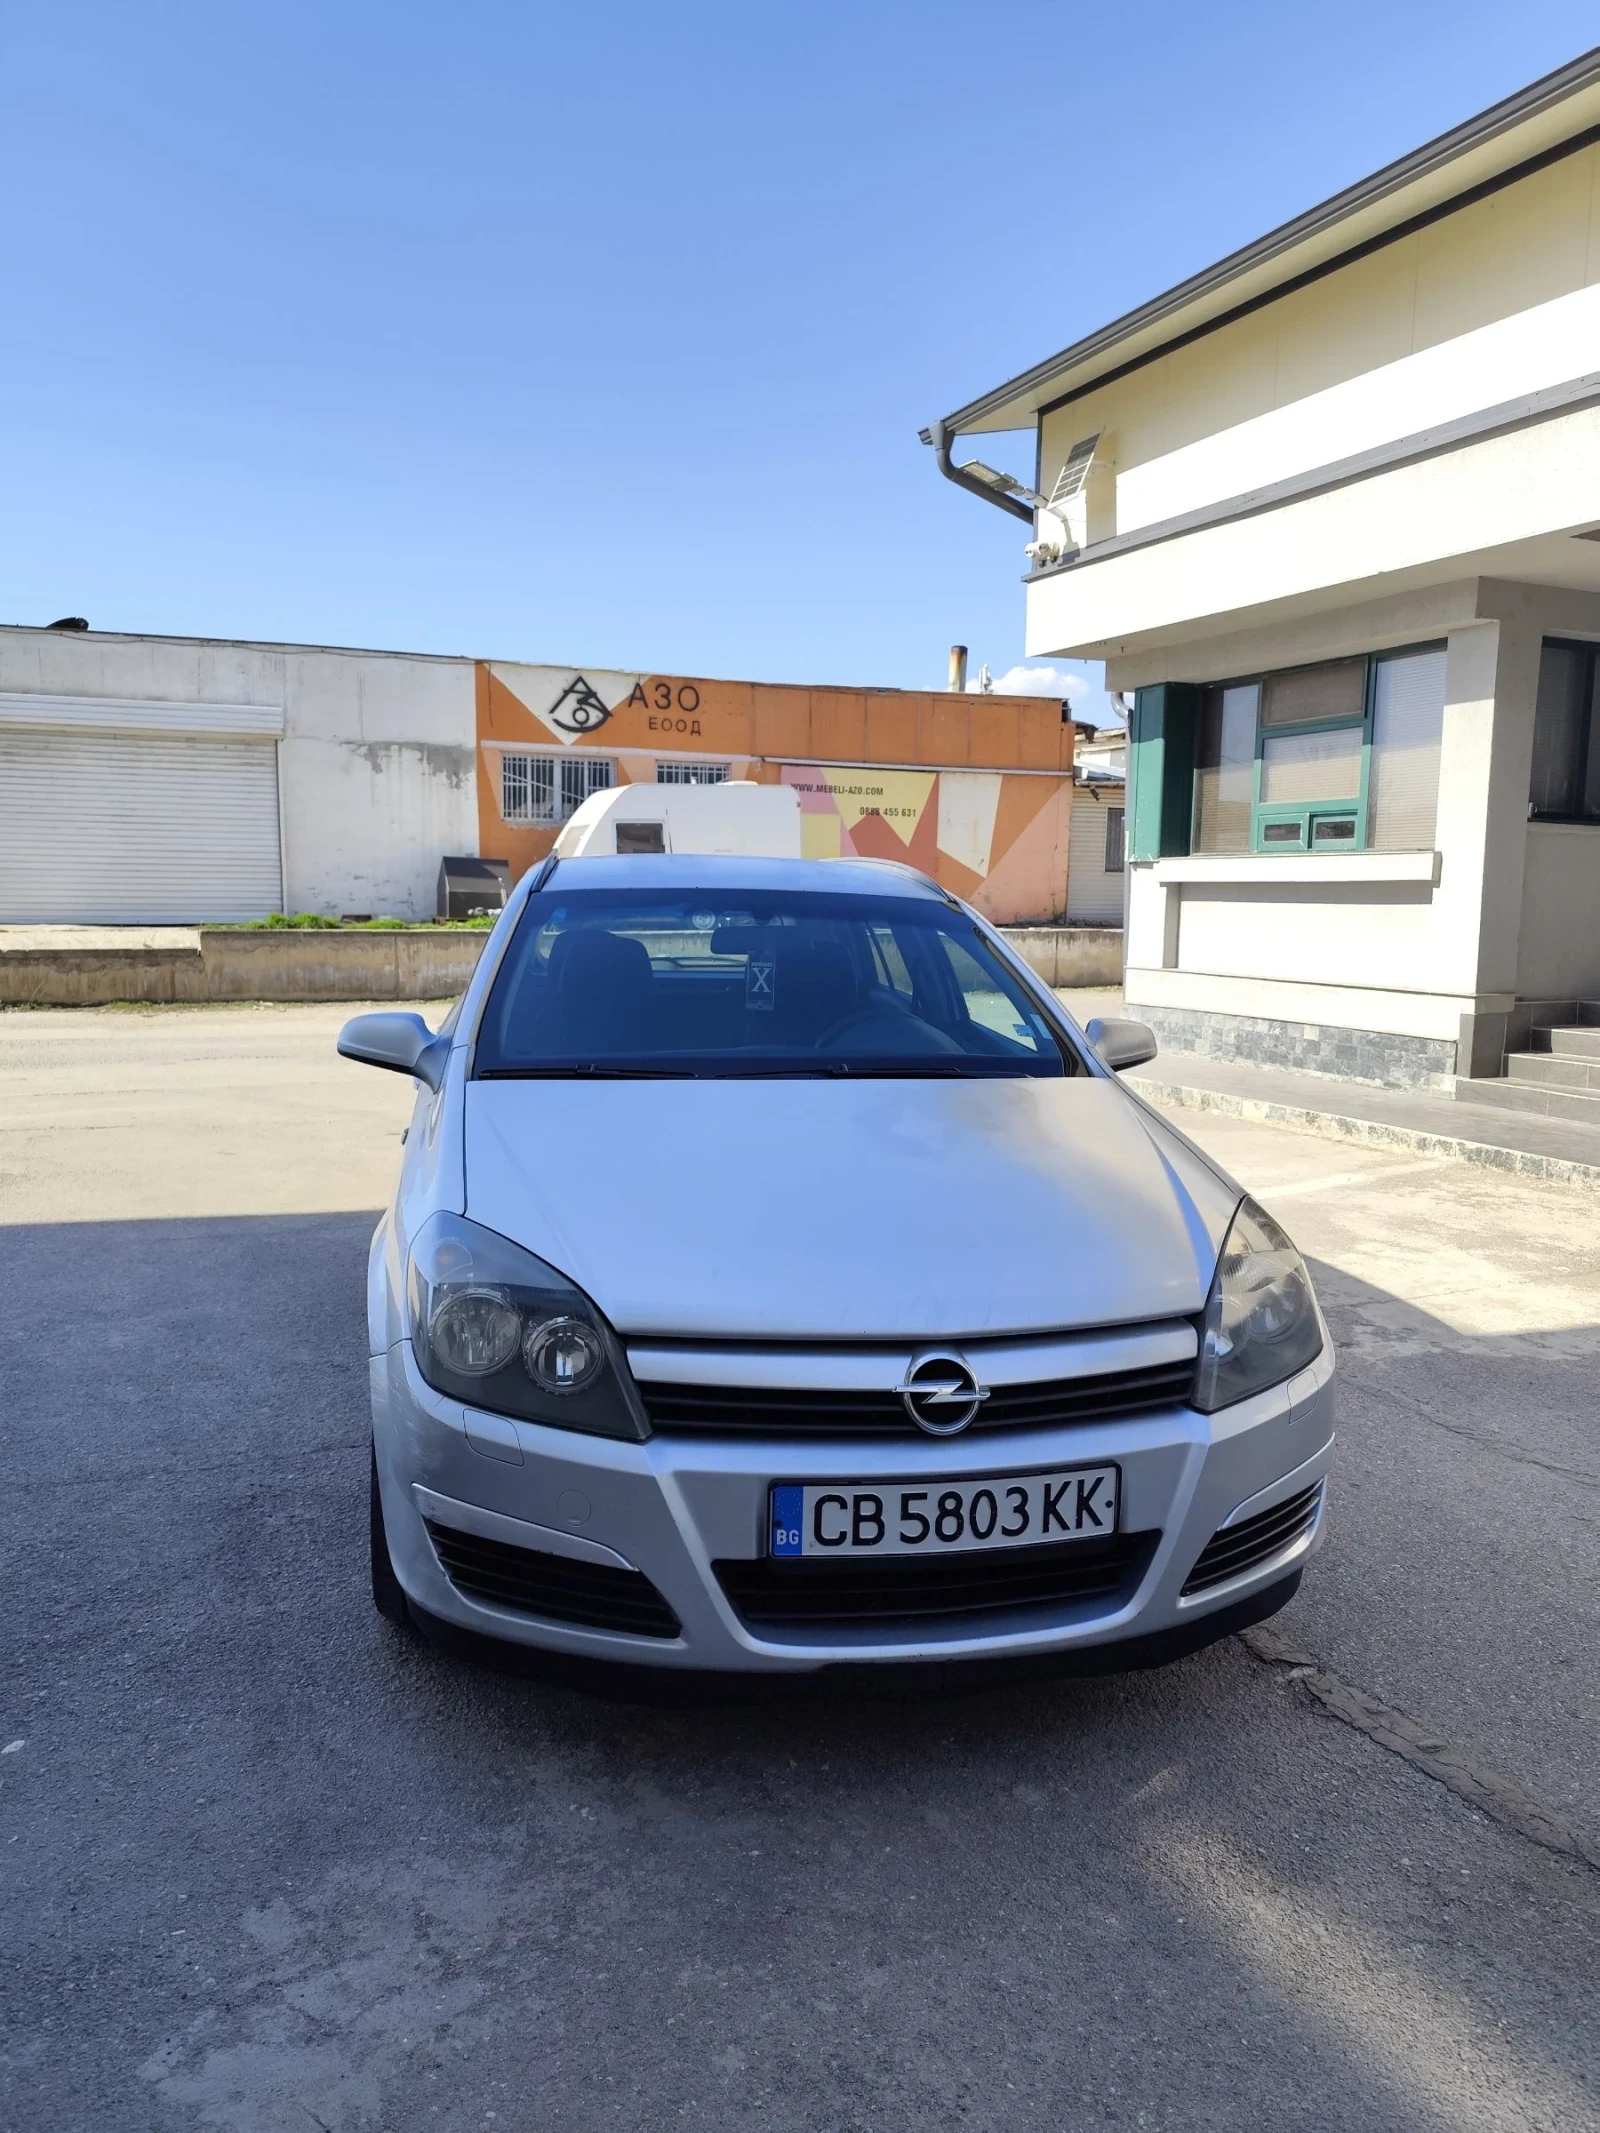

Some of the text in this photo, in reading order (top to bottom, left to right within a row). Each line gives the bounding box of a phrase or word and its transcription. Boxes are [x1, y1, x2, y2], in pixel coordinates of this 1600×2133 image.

[628, 682, 700, 712] АЗО
[649, 716, 701, 736] ЕООД
[883, 807, 899, 817] 455
[901, 808, 916, 818] 631
[751, 967, 772, 993] X
[900, 1486, 1029, 1545] 5803
[776, 1529, 800, 1546] BG
